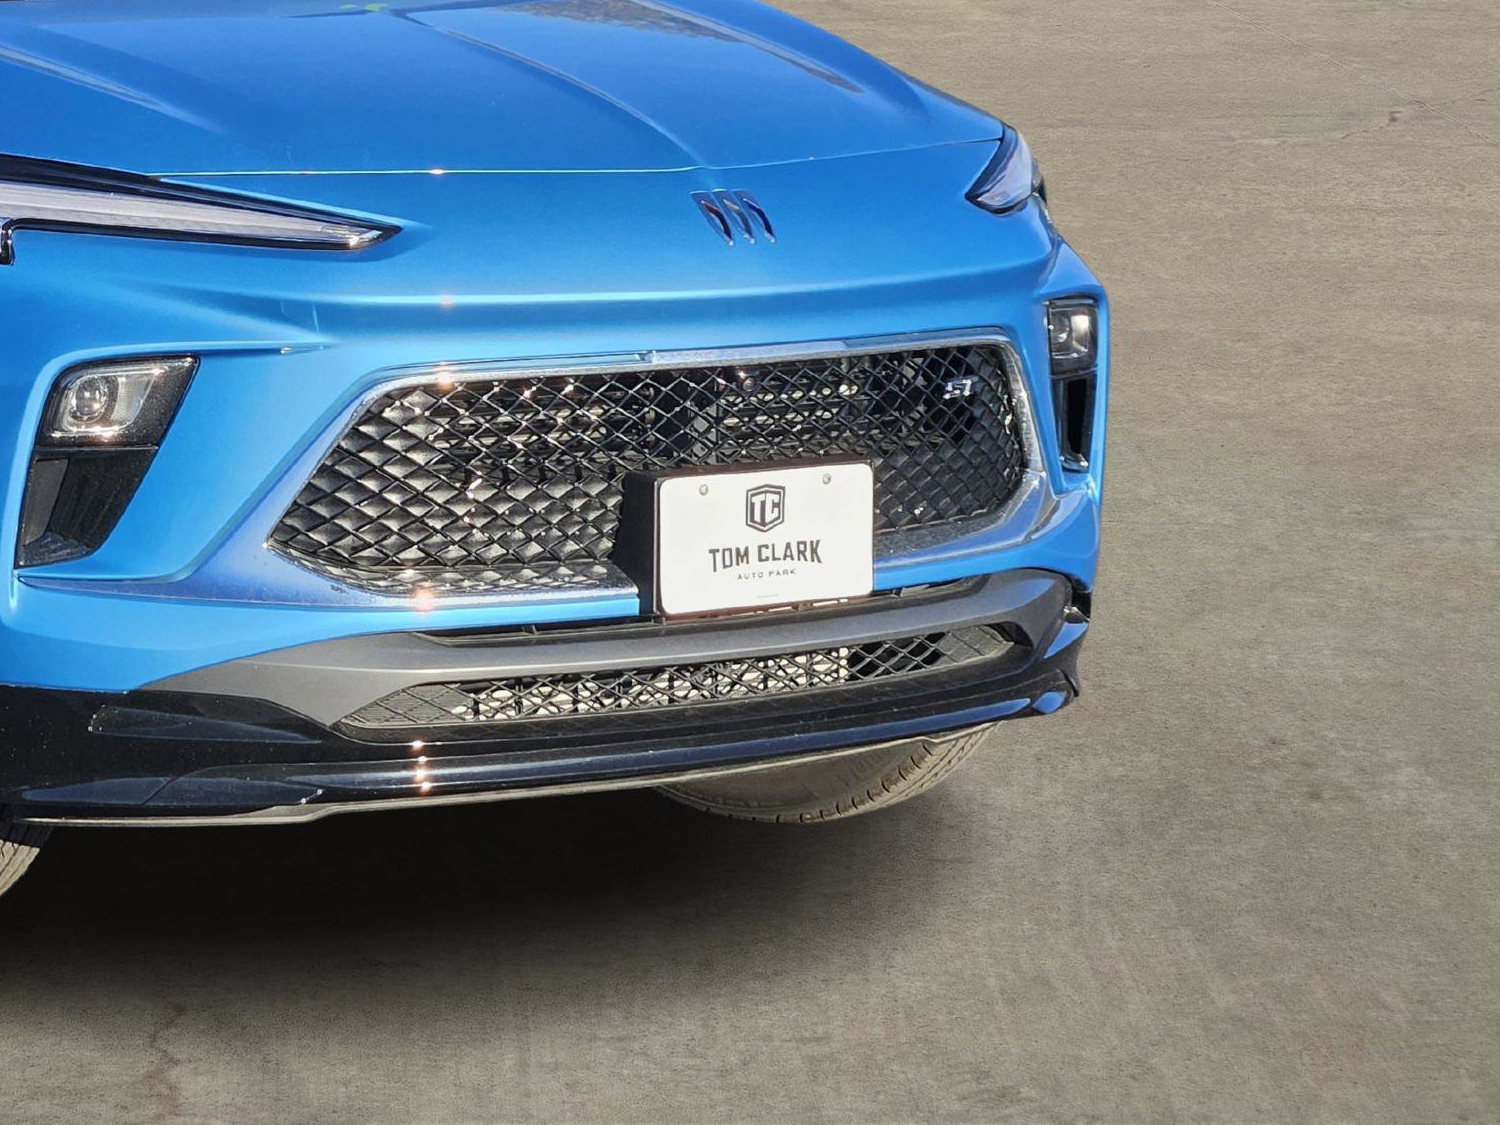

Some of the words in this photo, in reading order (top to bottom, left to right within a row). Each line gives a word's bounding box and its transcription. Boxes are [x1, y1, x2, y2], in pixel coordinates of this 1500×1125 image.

[708, 546, 750, 573] TOM
[757, 539, 823, 563] CLARK
[736, 572, 764, 581] AUTO
[768, 568, 797, 578] PARK
